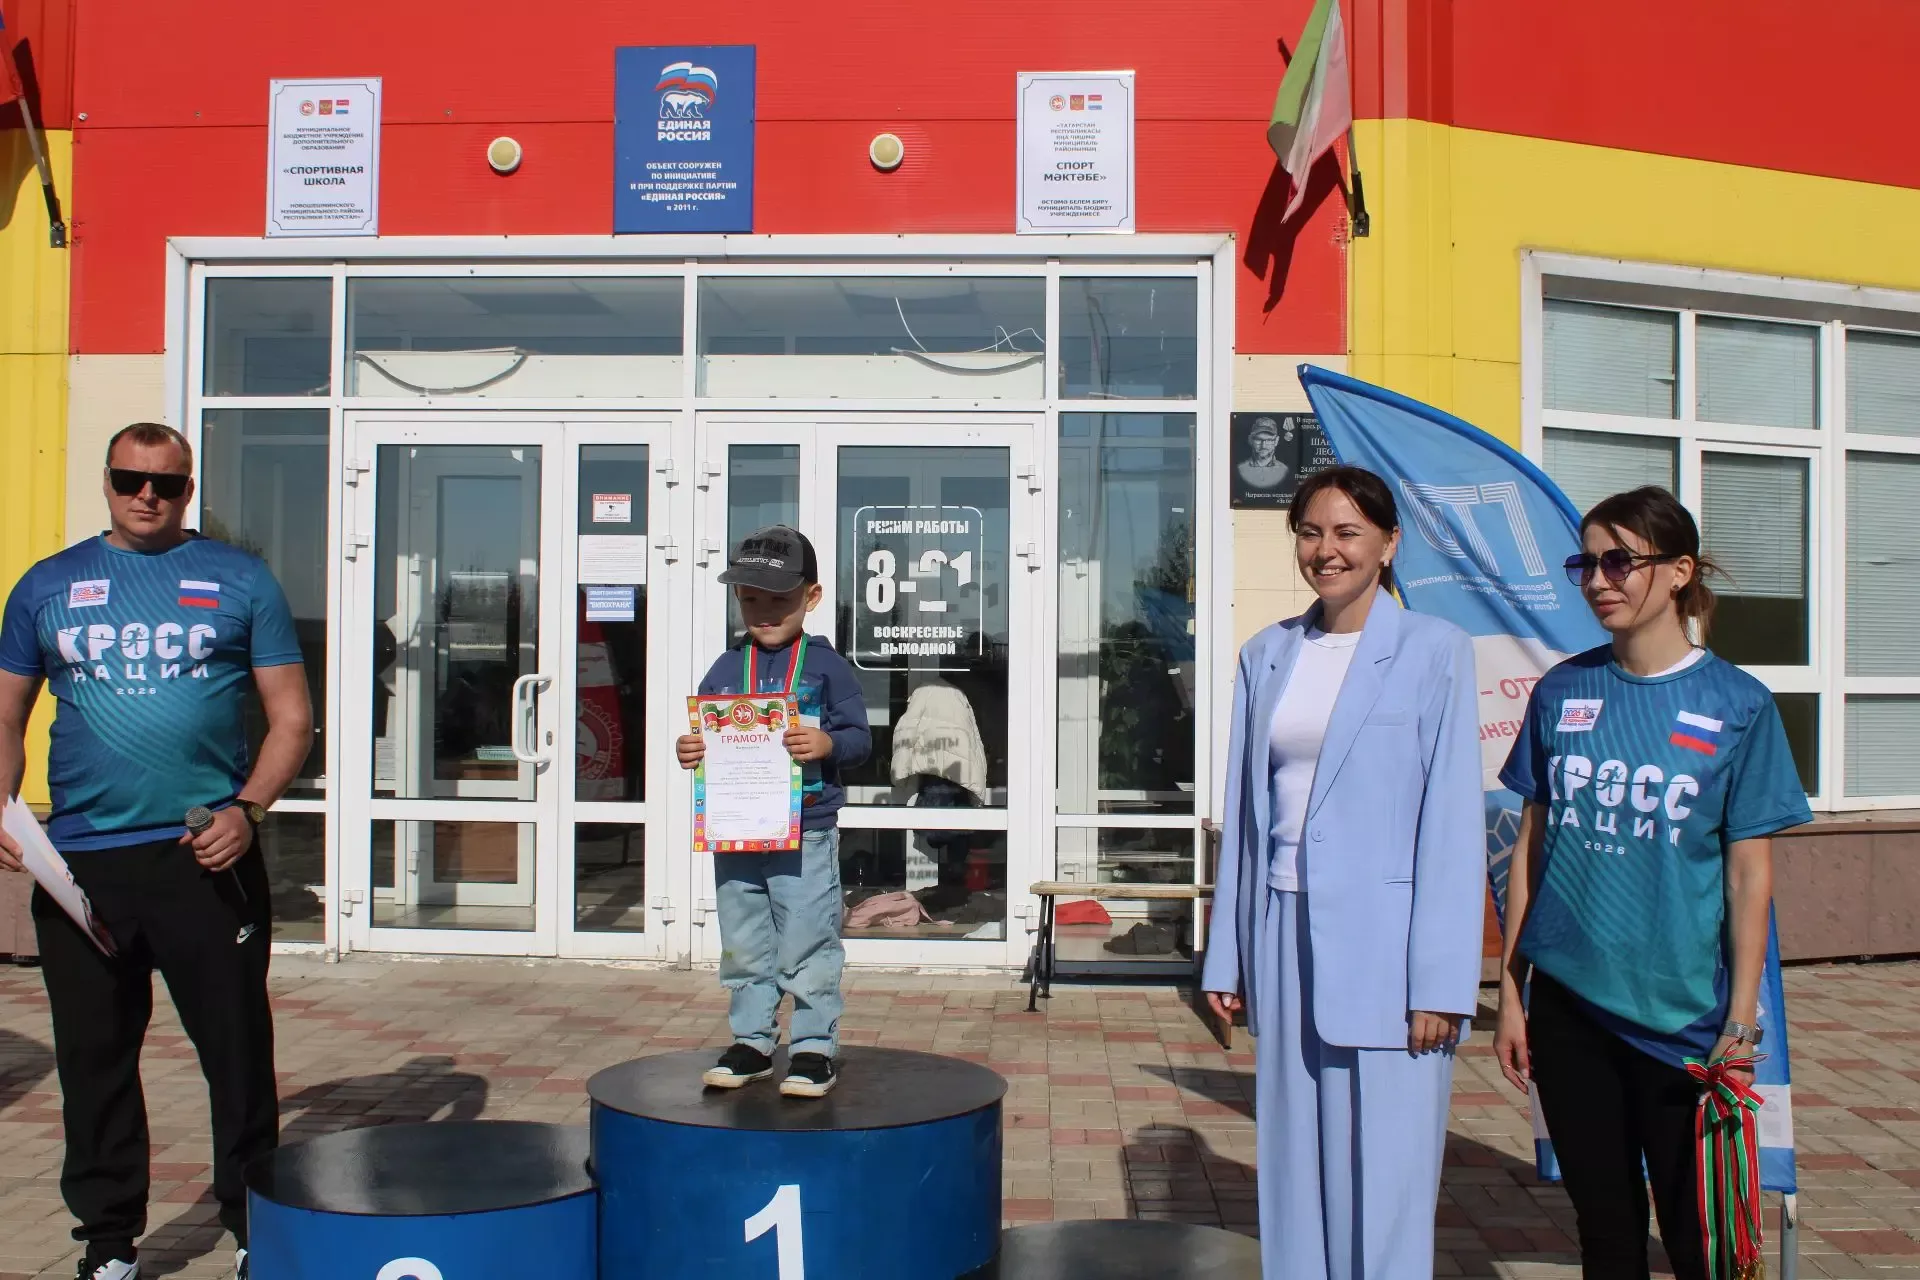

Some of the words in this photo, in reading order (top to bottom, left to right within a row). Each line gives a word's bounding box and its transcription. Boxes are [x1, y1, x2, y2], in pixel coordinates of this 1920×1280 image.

[657, 120, 711, 131] ЕДИНАЯ
[657, 131, 711, 141] РОССИЯ
[283, 166, 364, 175] «СПОРТИВНАЯ
[646, 162, 677, 170] ОБЪЕКТ
[1056, 161, 1095, 170] СПОРТ
[651, 172, 663, 180] ПО
[664, 172, 717, 180] ИНИЦИАТИВЕ
[1043, 173, 1107, 182] МӘКТӘБЕ»
[303, 177, 346, 186] ШКОЛА
[655, 183, 704, 191] ПОДДЕРЖКЕ
[641, 192, 684, 202] «ЕДИНАЯ
[685, 192, 726, 201] РОССИЯ»
[1315, 447, 1335, 456] ЛЕО
[1312, 457, 1340, 465] ЮРЬЕ
[915, 520, 969, 534] РАБОТЫ
[873, 626, 963, 639] ВОСКРЕСЕНЬЕ
[57, 622, 217, 664] КРОСС
[880, 641, 956, 656] ВЫХОДНОЙ
[71, 663, 209, 683] НАЦИИ
[721, 734, 770, 744] ГРАМОТА
[1584, 840, 1625, 855] 2026
[744, 1183, 805, 1280] 1
